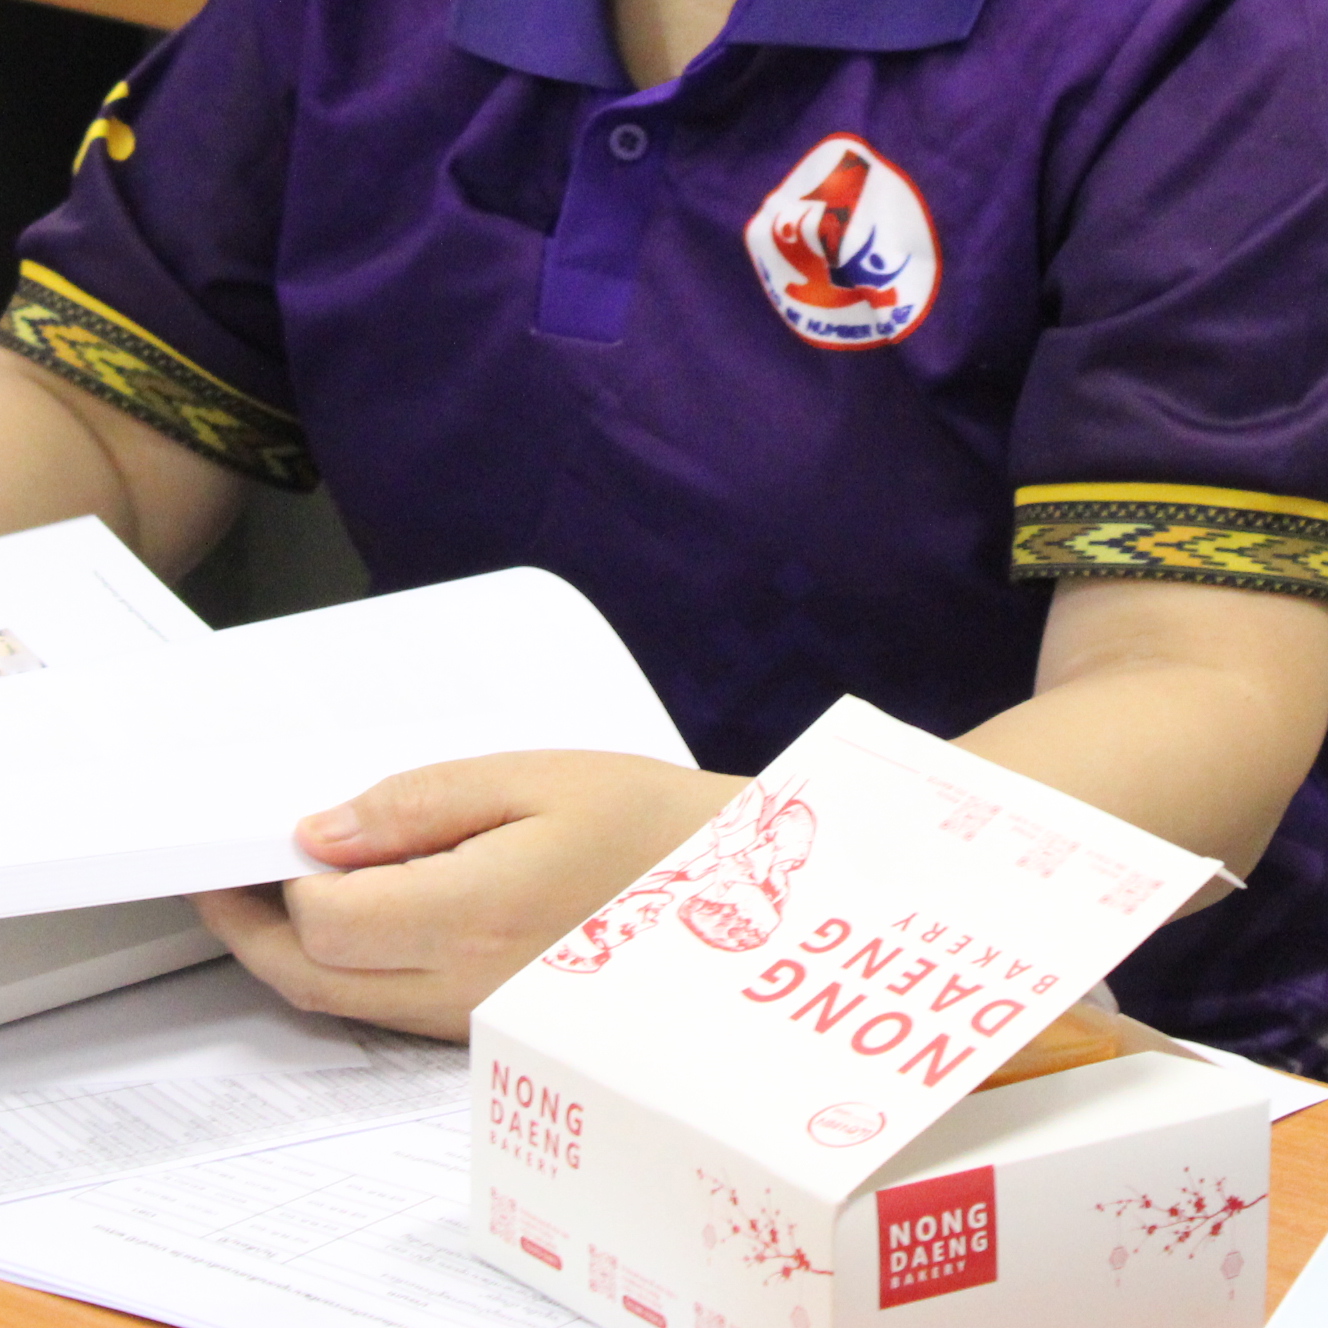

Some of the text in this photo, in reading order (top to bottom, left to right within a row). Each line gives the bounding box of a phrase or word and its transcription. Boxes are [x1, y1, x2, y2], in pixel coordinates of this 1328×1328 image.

[799, 917, 1027, 1039] DAENG
[890, 912, 1060, 996] BAKERY
[742, 957, 976, 1089] NONG
[490, 1097, 581, 1170] DAENG
[491, 1059, 584, 1137] NONG
[489, 1130, 559, 1179] BAKERY
[889, 1202, 988, 1249] NONG
[889, 1230, 988, 1273] DAENG
[889, 1260, 966, 1289] BAKERY
